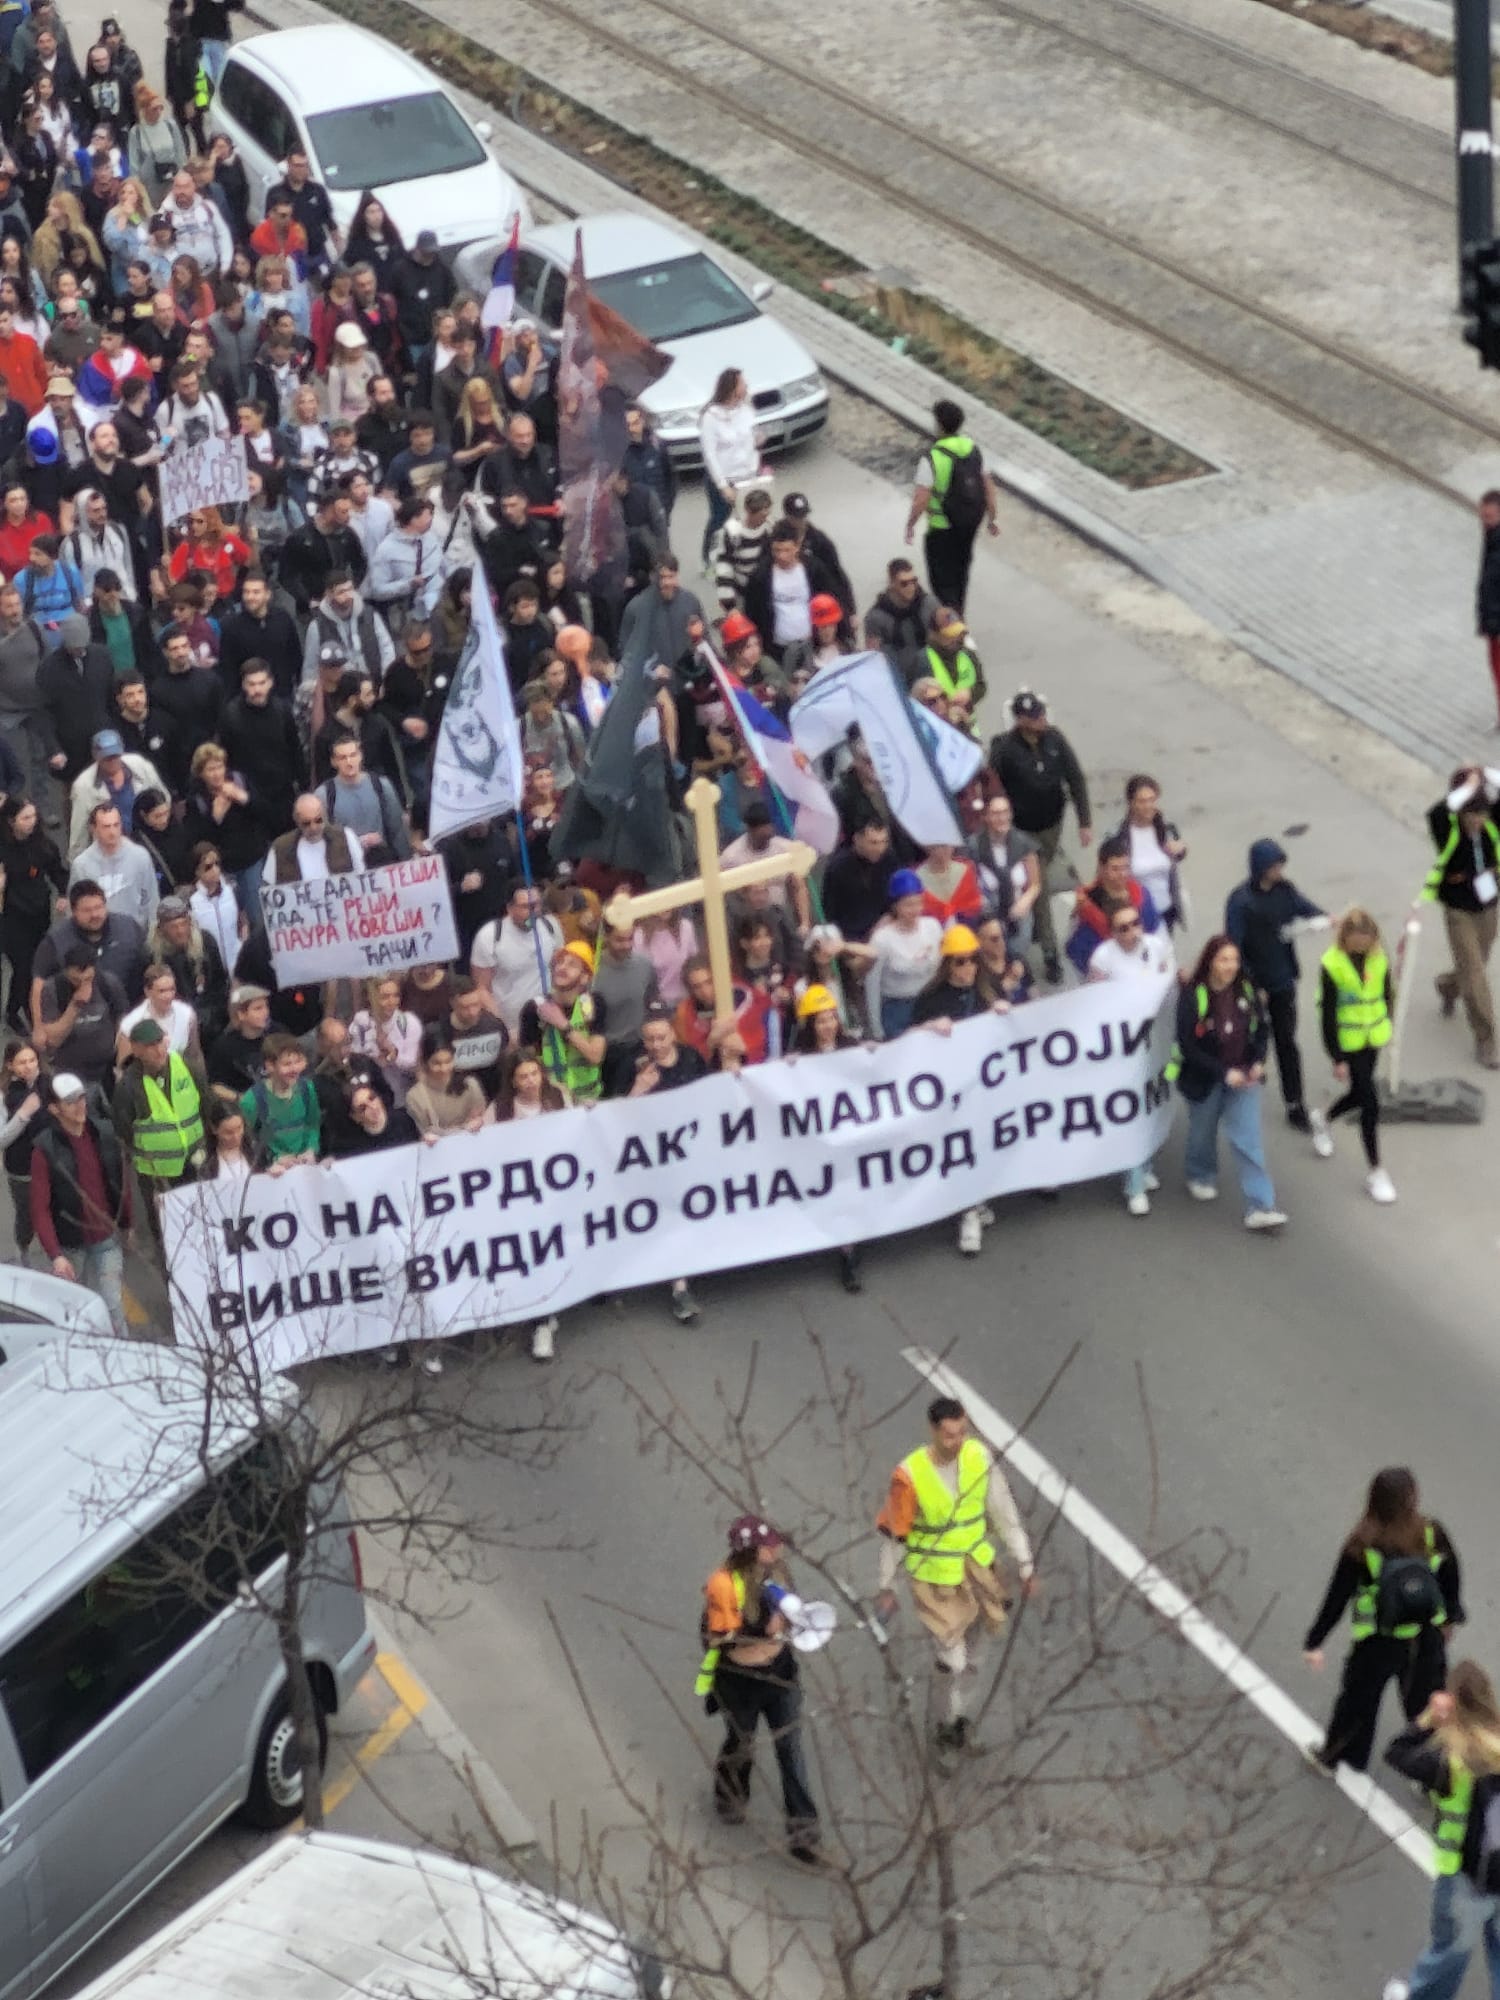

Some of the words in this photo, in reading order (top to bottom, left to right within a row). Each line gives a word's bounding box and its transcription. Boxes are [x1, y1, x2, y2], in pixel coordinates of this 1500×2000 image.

[261, 888, 285, 909] КО
[324, 876, 353, 898] ДА
[358, 871, 382, 894] ТЕ
[384, 859, 439, 888] ТЕШИ
[310, 902, 337, 923] ТЕ
[344, 891, 400, 921] РЕШИ
[208, 1264, 384, 1332] ВИШЕ
[405, 1223, 565, 1294] ВИДИ
[583, 1198, 659, 1248] НО
[680, 1164, 834, 1222] ОНАЈ
[857, 1130, 976, 1189] ПОД
[992, 1066, 1170, 1150] БРДОМ
[222, 1212, 298, 1256] КО
[320, 1194, 400, 1240] НА
[421, 1152, 595, 1218] БРДО,
[720, 1108, 757, 1148] И
[780, 1073, 962, 1138] МАЛО,
[979, 1017, 1155, 1088] СТОЈИ
